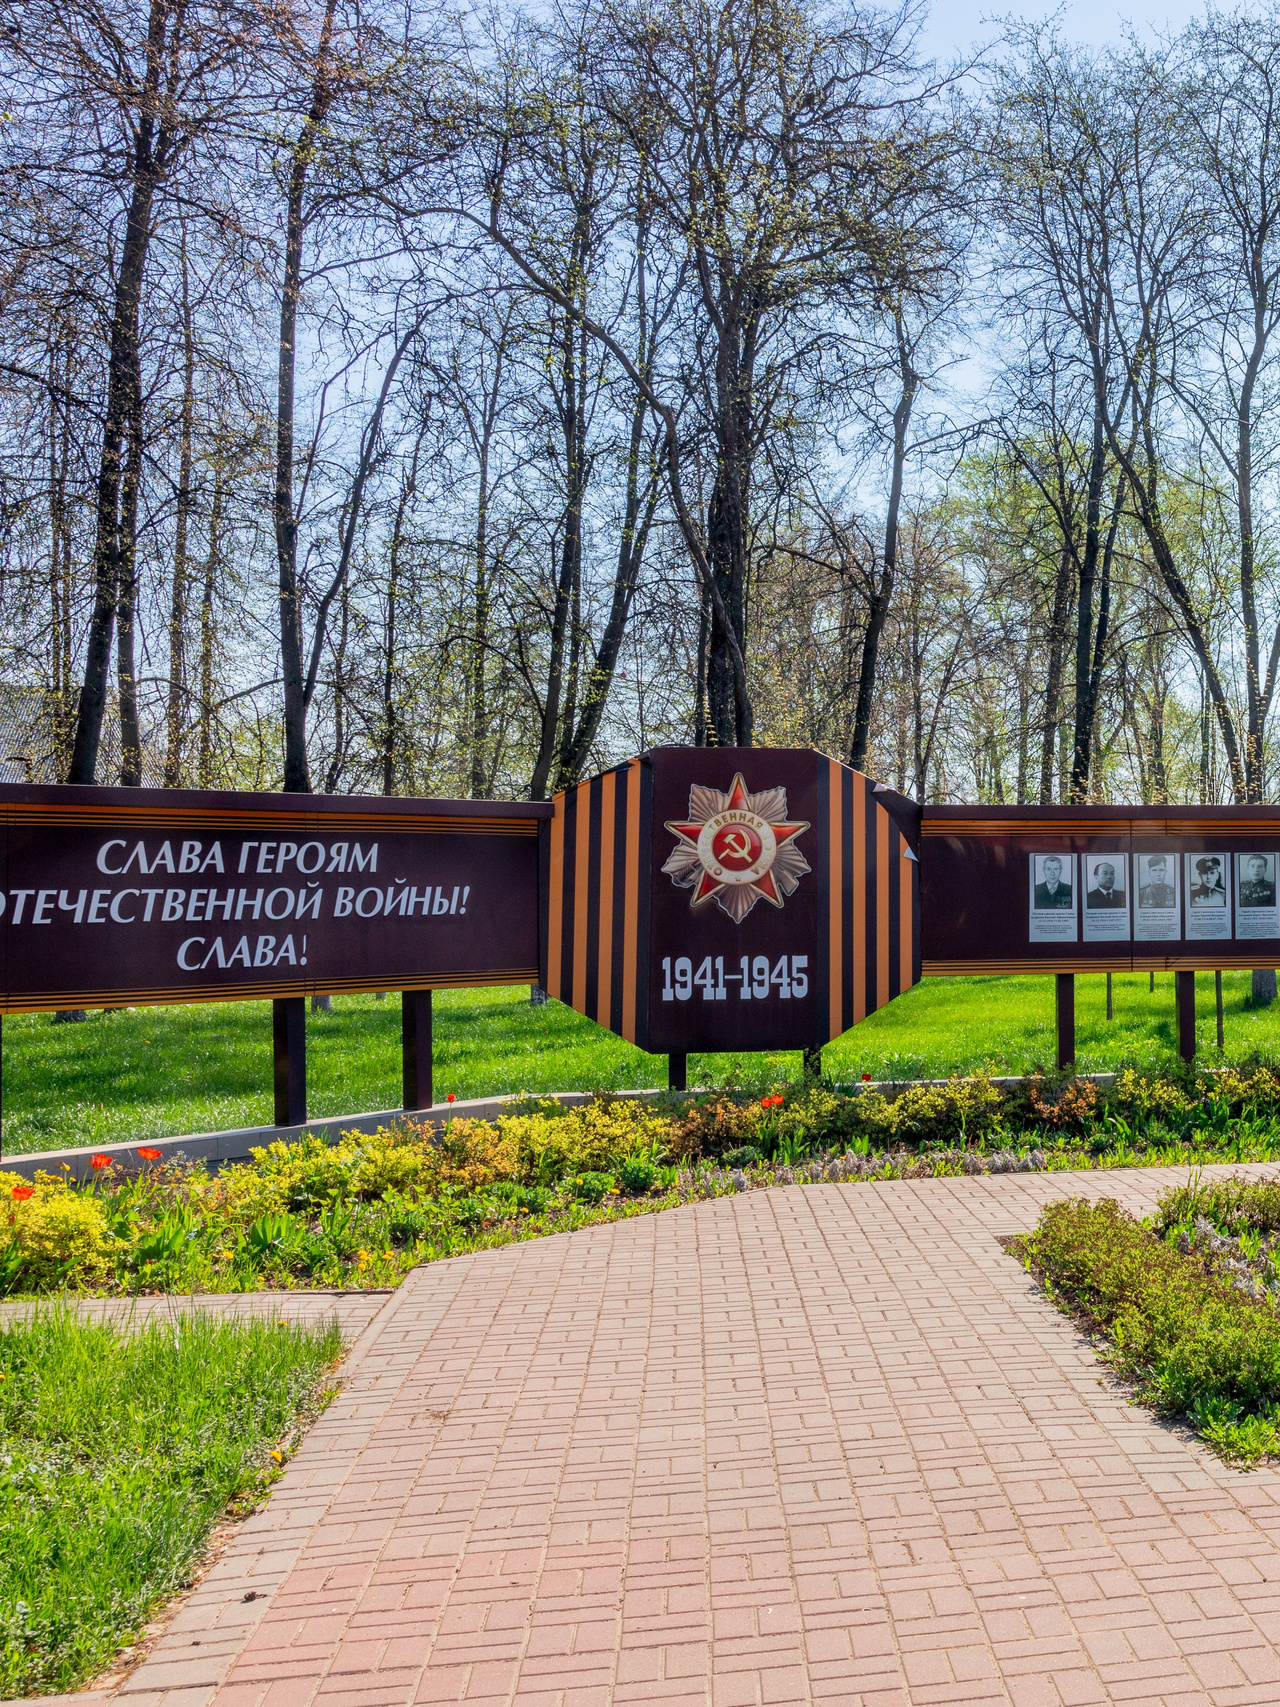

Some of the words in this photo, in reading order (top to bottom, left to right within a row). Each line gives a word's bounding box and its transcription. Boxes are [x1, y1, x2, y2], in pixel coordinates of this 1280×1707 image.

[97, 840, 224, 874] СЛАВА
[238, 842, 378, 873] ГЕРОЯМ
[0, 882, 321, 925] ТЕЧЕСТВЕННОЙ
[333, 878, 470, 917] ВОЙНЫ!
[177, 934, 307, 970] СЛАВА!
[663, 955, 807, 1000] 1941-1945
